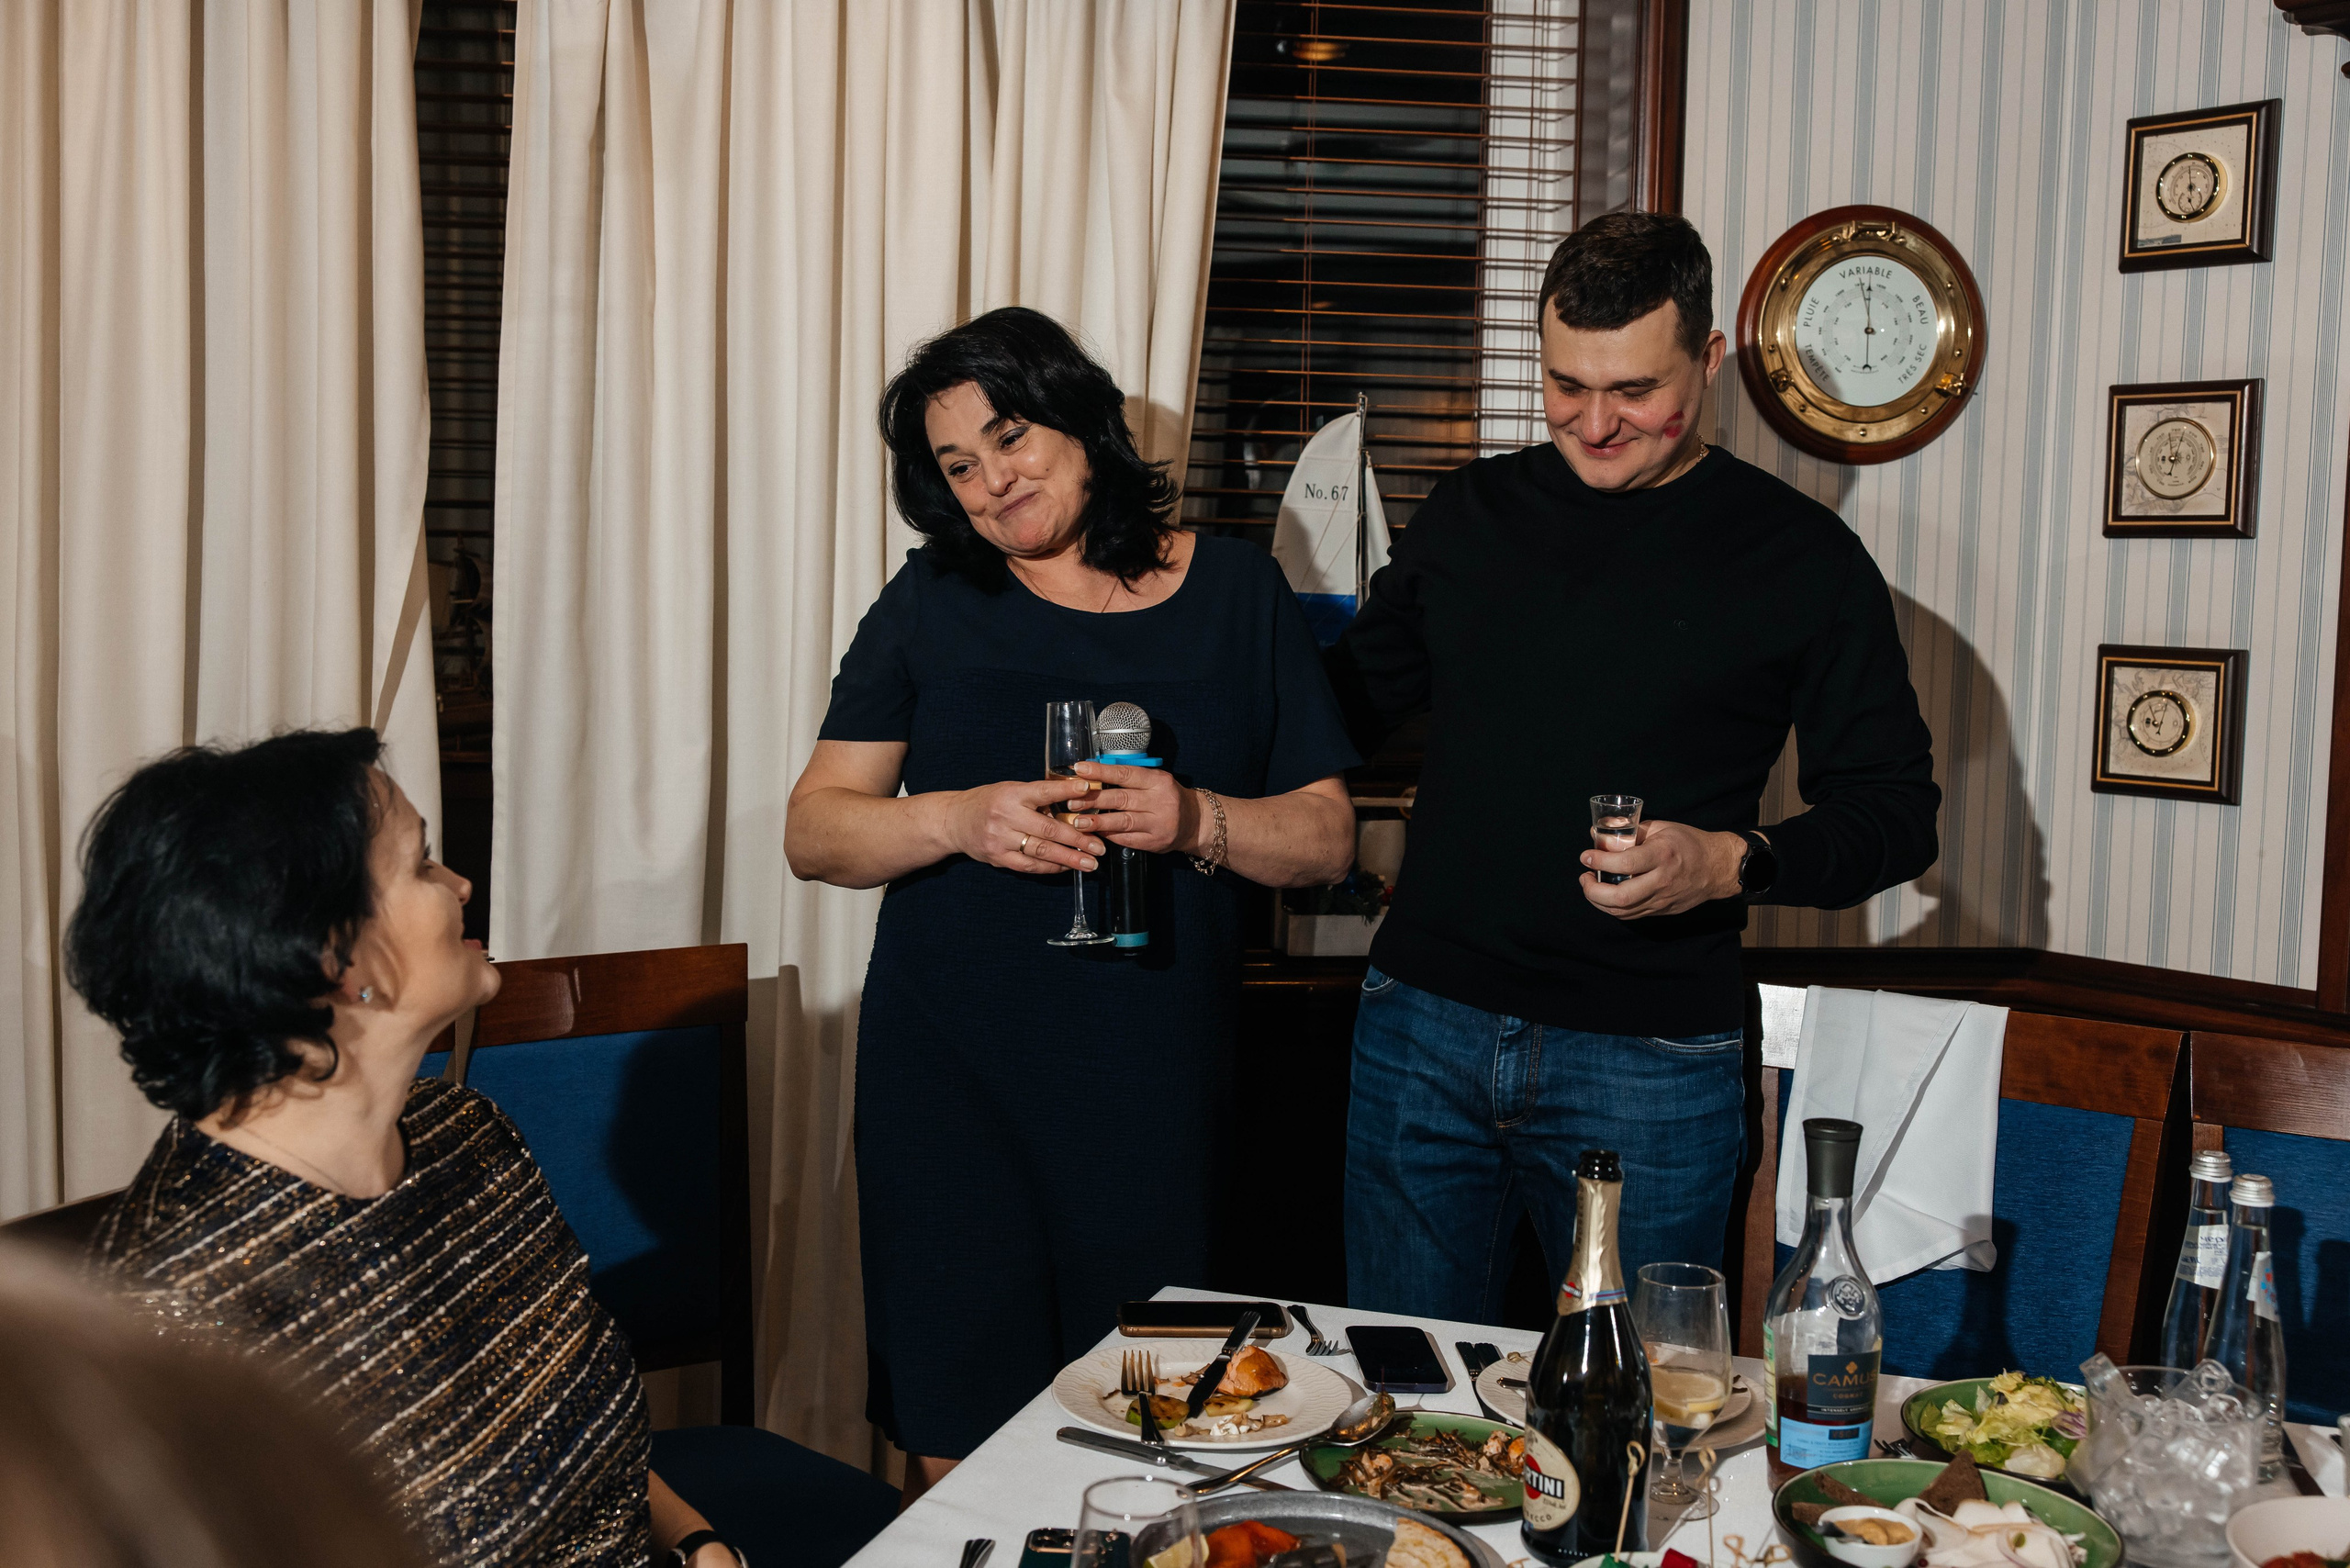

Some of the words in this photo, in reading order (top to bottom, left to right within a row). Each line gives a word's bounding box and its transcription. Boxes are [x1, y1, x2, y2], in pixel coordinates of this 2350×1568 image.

[1839, 266, 1892, 279] VARIABLE
[1803, 297, 1820, 328] PLUIE
[1912, 295, 1929, 325] BEAU
[1915, 343, 1928, 363] SEC
[1304, 483, 1327, 500] No.
[1331, 485, 1349, 501] 67
[1812, 1369, 1878, 1387] CAMUS
[1525, 1465, 1563, 1498] RTINI
